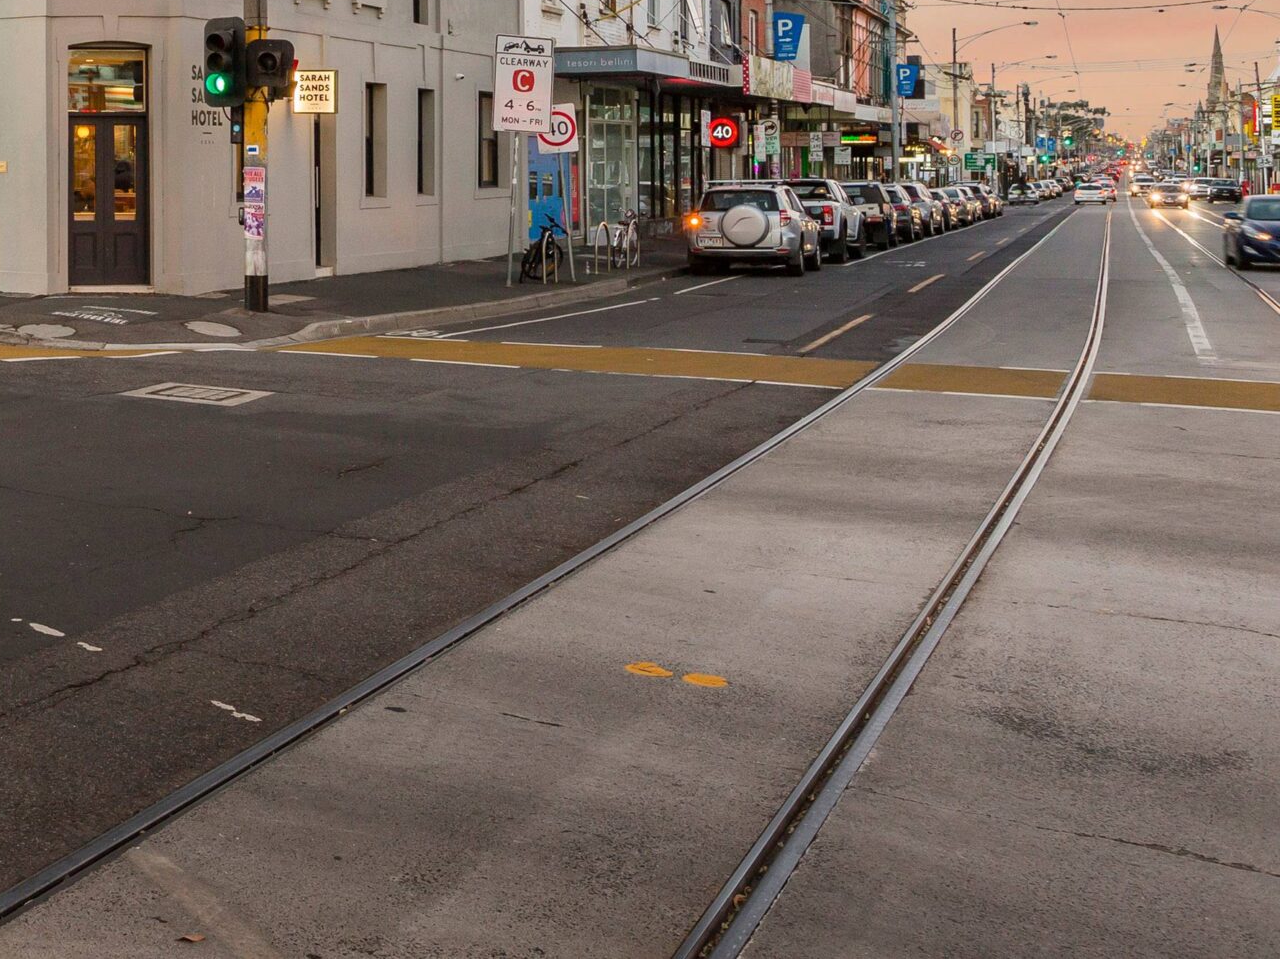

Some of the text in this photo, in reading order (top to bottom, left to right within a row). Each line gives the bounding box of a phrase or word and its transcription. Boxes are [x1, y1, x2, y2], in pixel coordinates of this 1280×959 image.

[778, 19, 793, 37] P
[500, 57, 549, 68] CLEARWAY
[299, 74, 330, 82] SARAH
[900, 68, 910, 80] P
[517, 71, 530, 91] C
[299, 84, 330, 92] SANDS
[299, 94, 329, 102] HOTEL
[504, 100, 514, 110] 4
[191, 110, 223, 127] HOTEL
[501, 116, 519, 124] MON
[529, 118, 543, 126] FRI
[712, 125, 732, 139] 40
